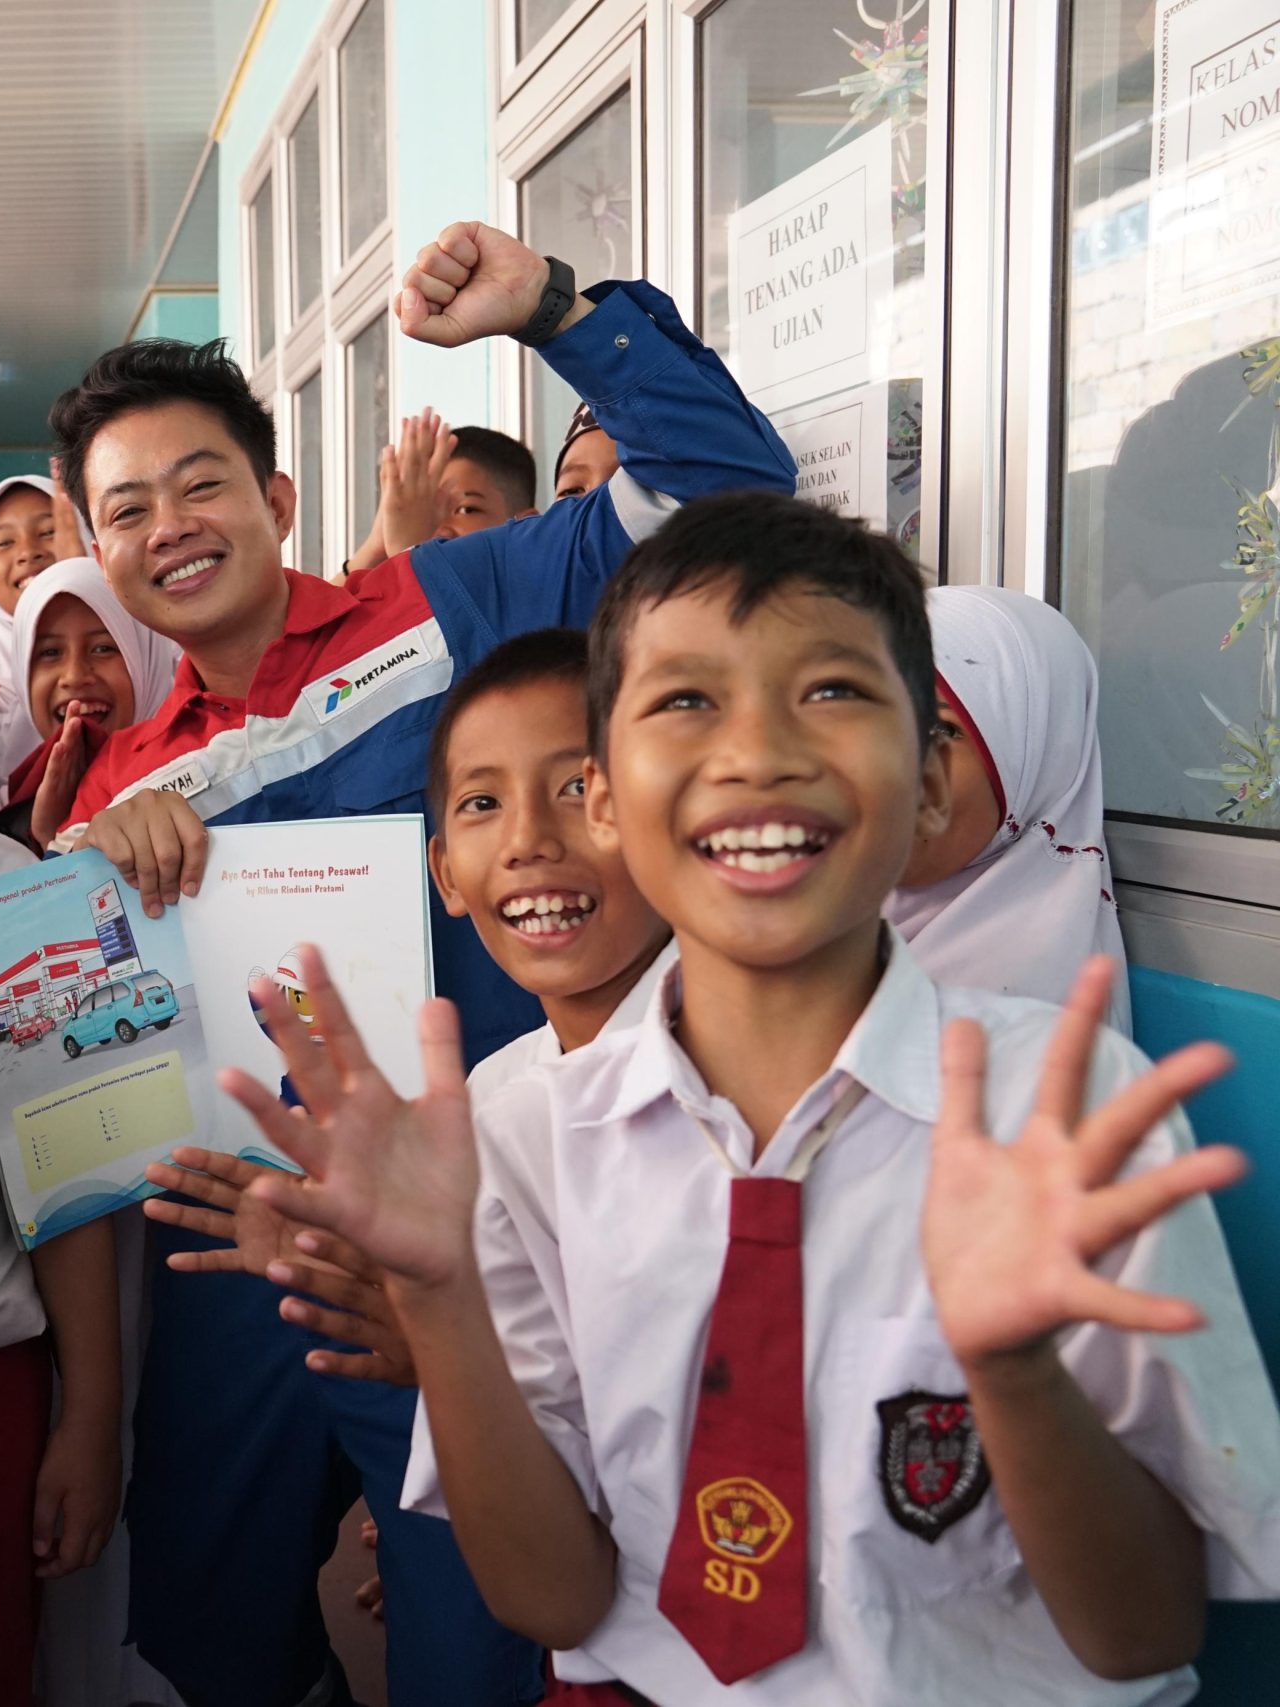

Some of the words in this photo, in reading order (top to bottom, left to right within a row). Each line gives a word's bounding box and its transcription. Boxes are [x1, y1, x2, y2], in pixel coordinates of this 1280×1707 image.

[1196, 37, 1276, 94] KELAS
[769, 202, 828, 256] HARAP
[744, 260, 813, 315] TENANG
[819, 239, 859, 282] ADA
[772, 304, 824, 349] UJIAN
[796, 449, 818, 468] ASUK
[819, 440, 852, 463] SELAIN
[796, 472, 817, 491] JIAN
[818, 468, 837, 487] DAN
[819, 490, 850, 508] TIDAK
[354, 648, 419, 689] PERTAMINA
[154, 772, 194, 792] SYAH
[221, 869, 238, 882] Ayo
[241, 868, 260, 880] Cari
[263, 867, 285, 879] Tahu
[288, 867, 325, 880] Tentang
[328, 864, 370, 877] Pesawat!
[21, 882, 42, 896] produk
[281, 884, 313, 894] Rindiani
[314, 883, 345, 893] Pratami
[704, 1559, 760, 1603] SD
